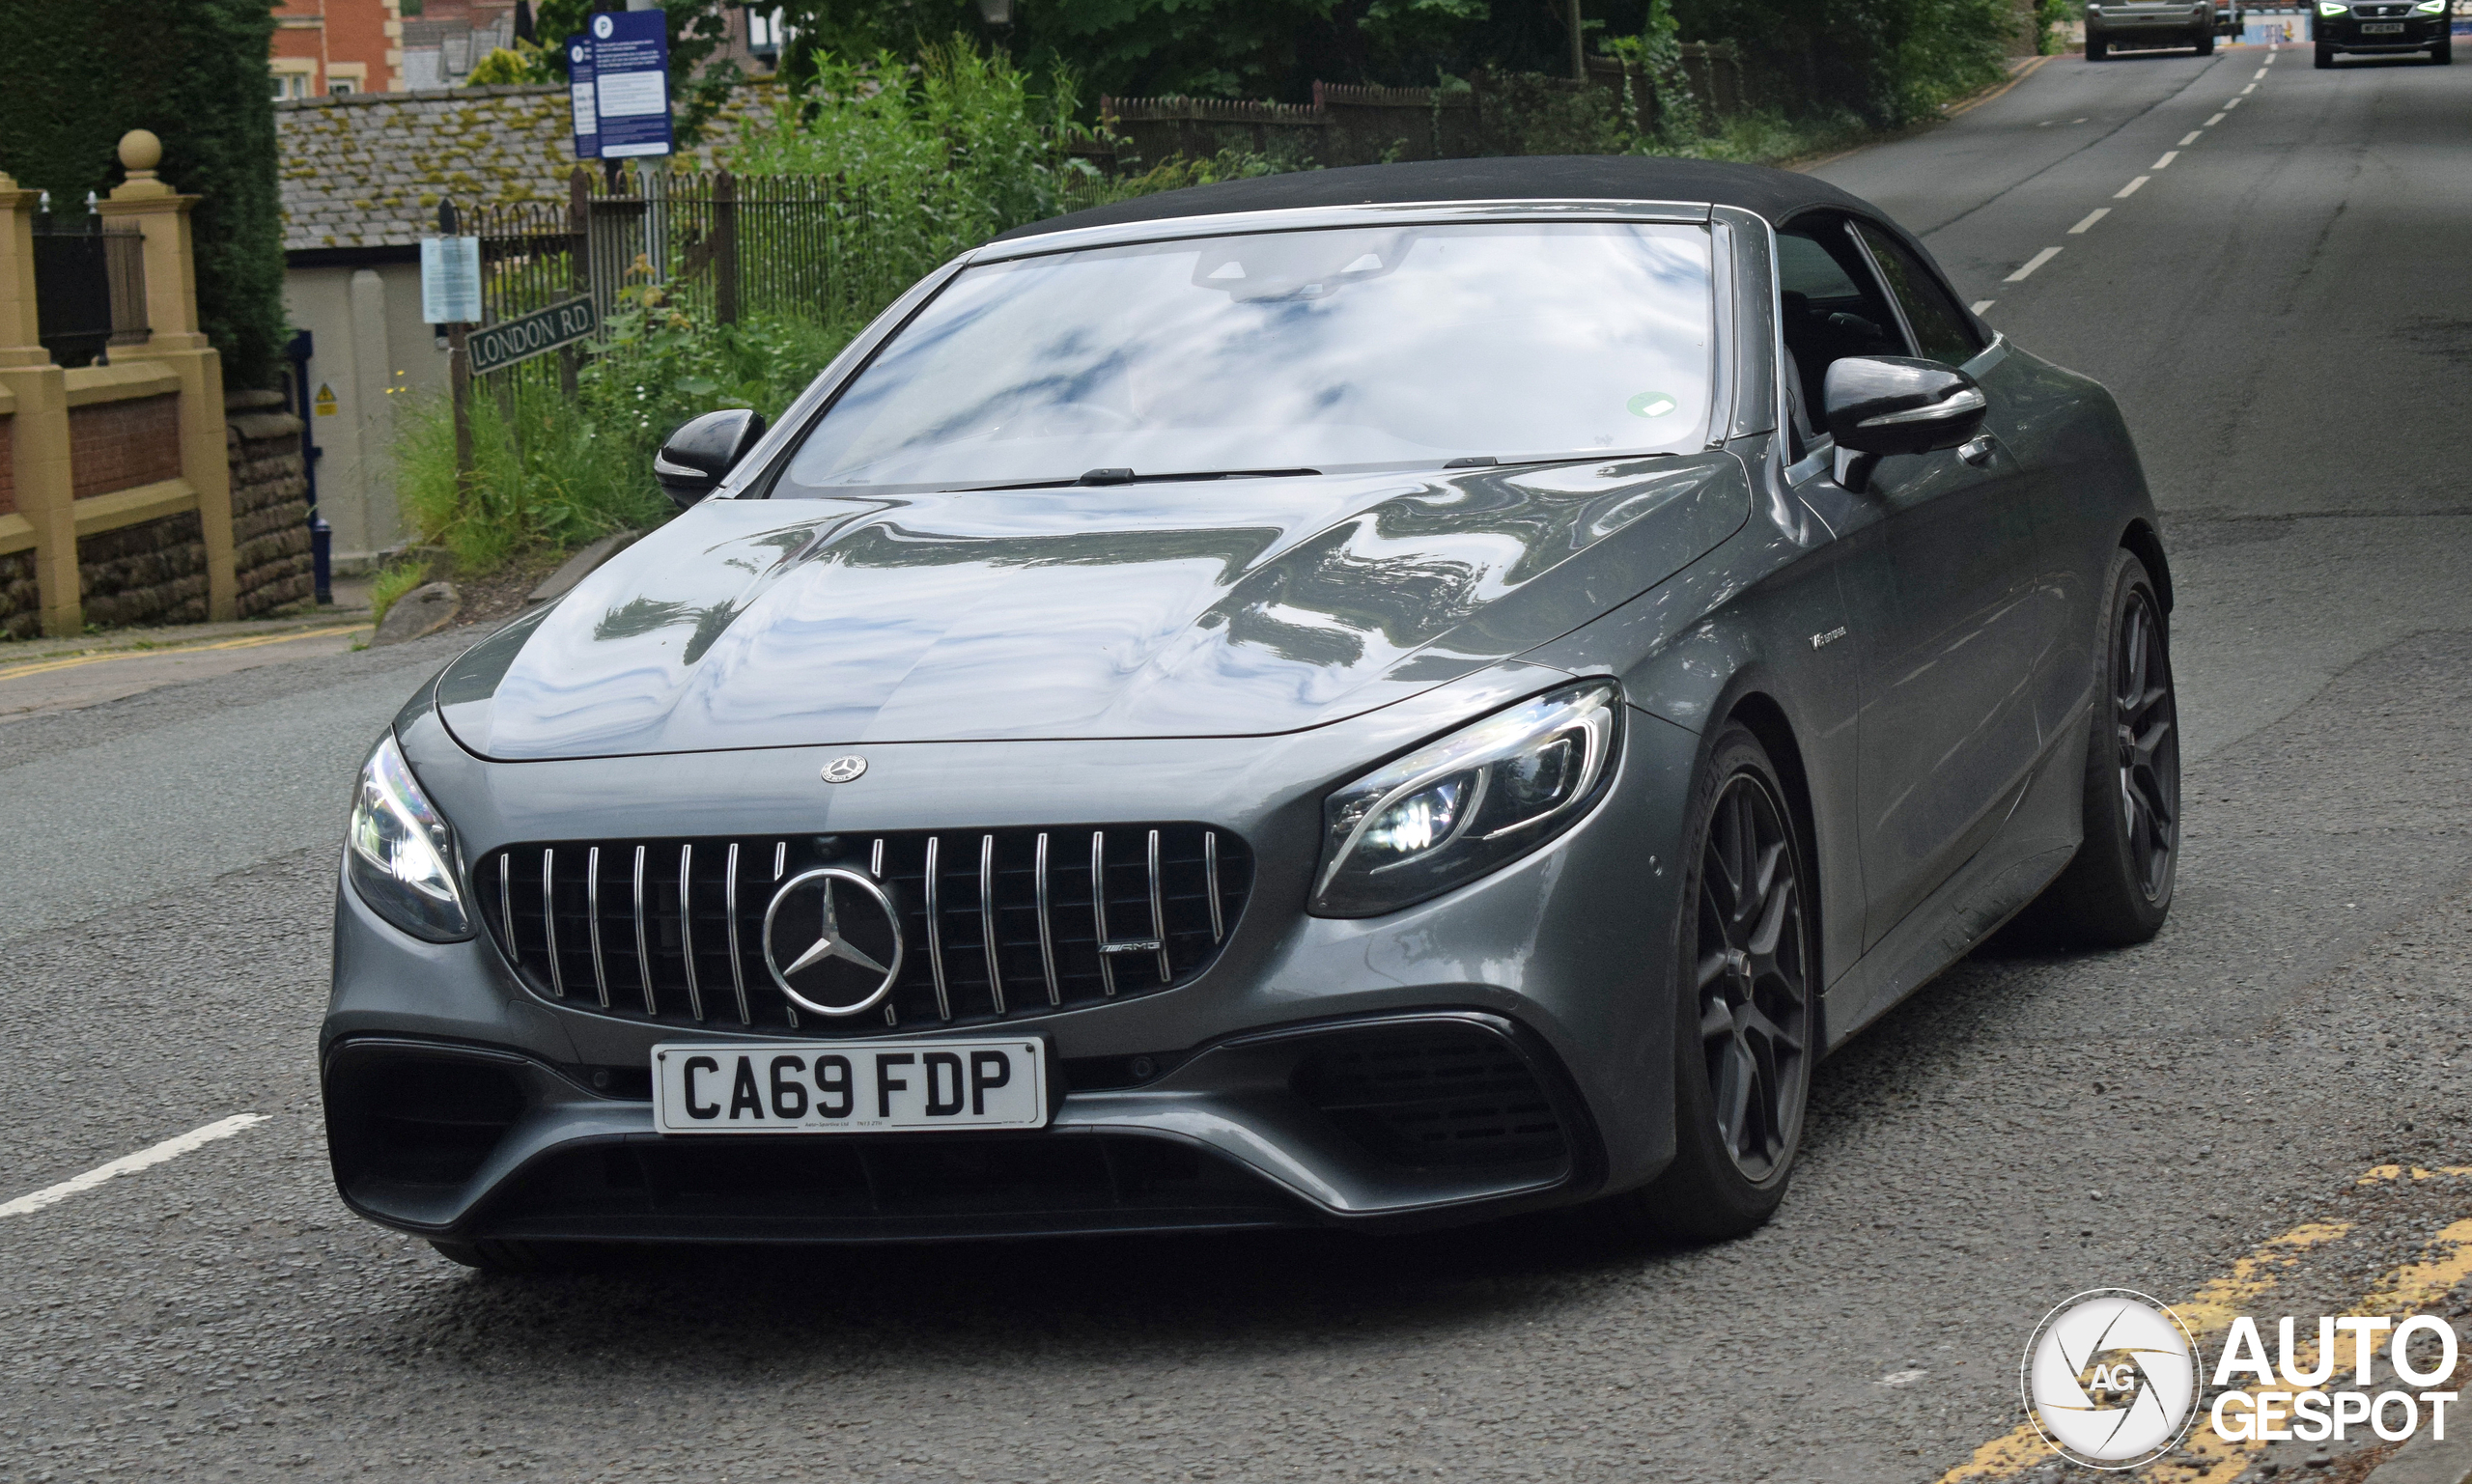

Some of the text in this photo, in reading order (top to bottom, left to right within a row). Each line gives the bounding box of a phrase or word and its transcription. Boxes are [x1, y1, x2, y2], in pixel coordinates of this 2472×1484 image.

[472, 315, 556, 366] LONDON
[684, 1050, 1011, 1120] CA69 FDP
